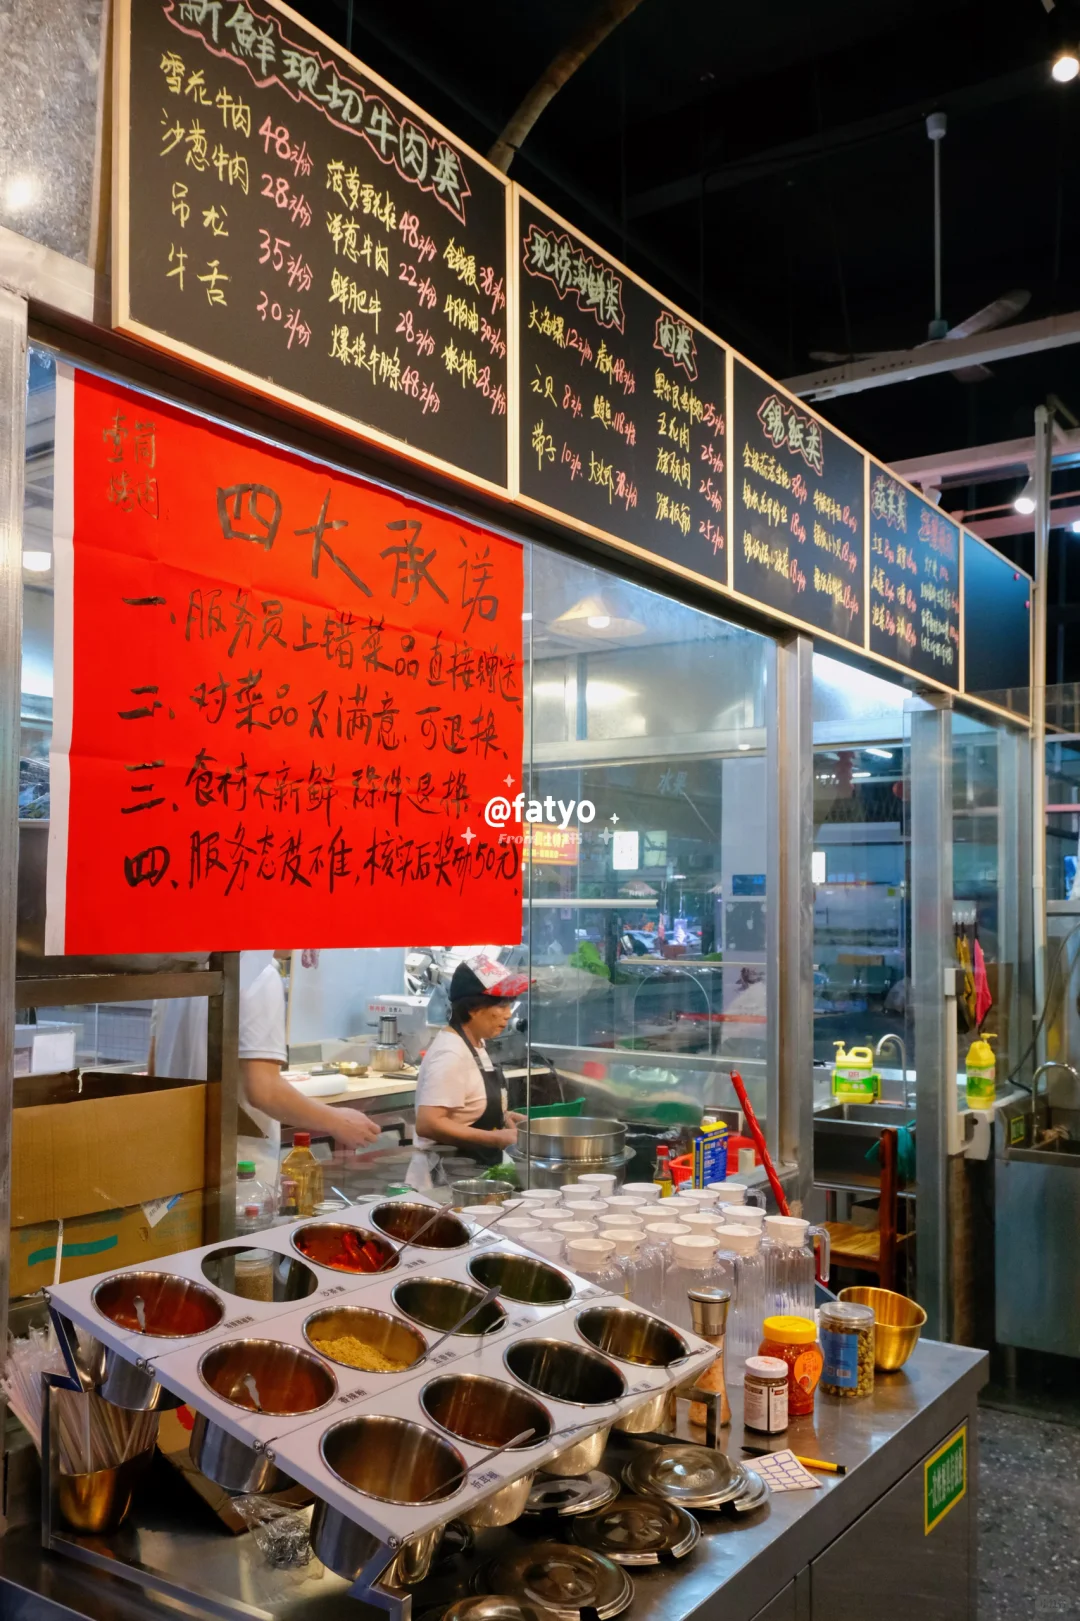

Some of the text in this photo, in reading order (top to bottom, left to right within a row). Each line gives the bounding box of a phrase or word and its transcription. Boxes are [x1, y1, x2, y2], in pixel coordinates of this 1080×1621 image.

[160, 51, 251, 138] 雪花牛肉
[160, 108, 249, 195] 沙葱牛肉
[172, 182, 229, 236] 吊龙
[166, 243, 229, 306] 牛舌
[325, 210, 389, 277] 洋葱牛肉
[328, 267, 381, 335] 鲜肥牛
[530, 231, 621, 326] 现捞海鲜类
[528, 301, 566, 349] 大海螺
[659, 318, 694, 372] 肉类
[532, 419, 557, 471] 带子
[657, 412, 690, 453] 五花肉
[762, 400, 821, 471] 锡纸类
[217, 484, 499, 633] 四大承诺
